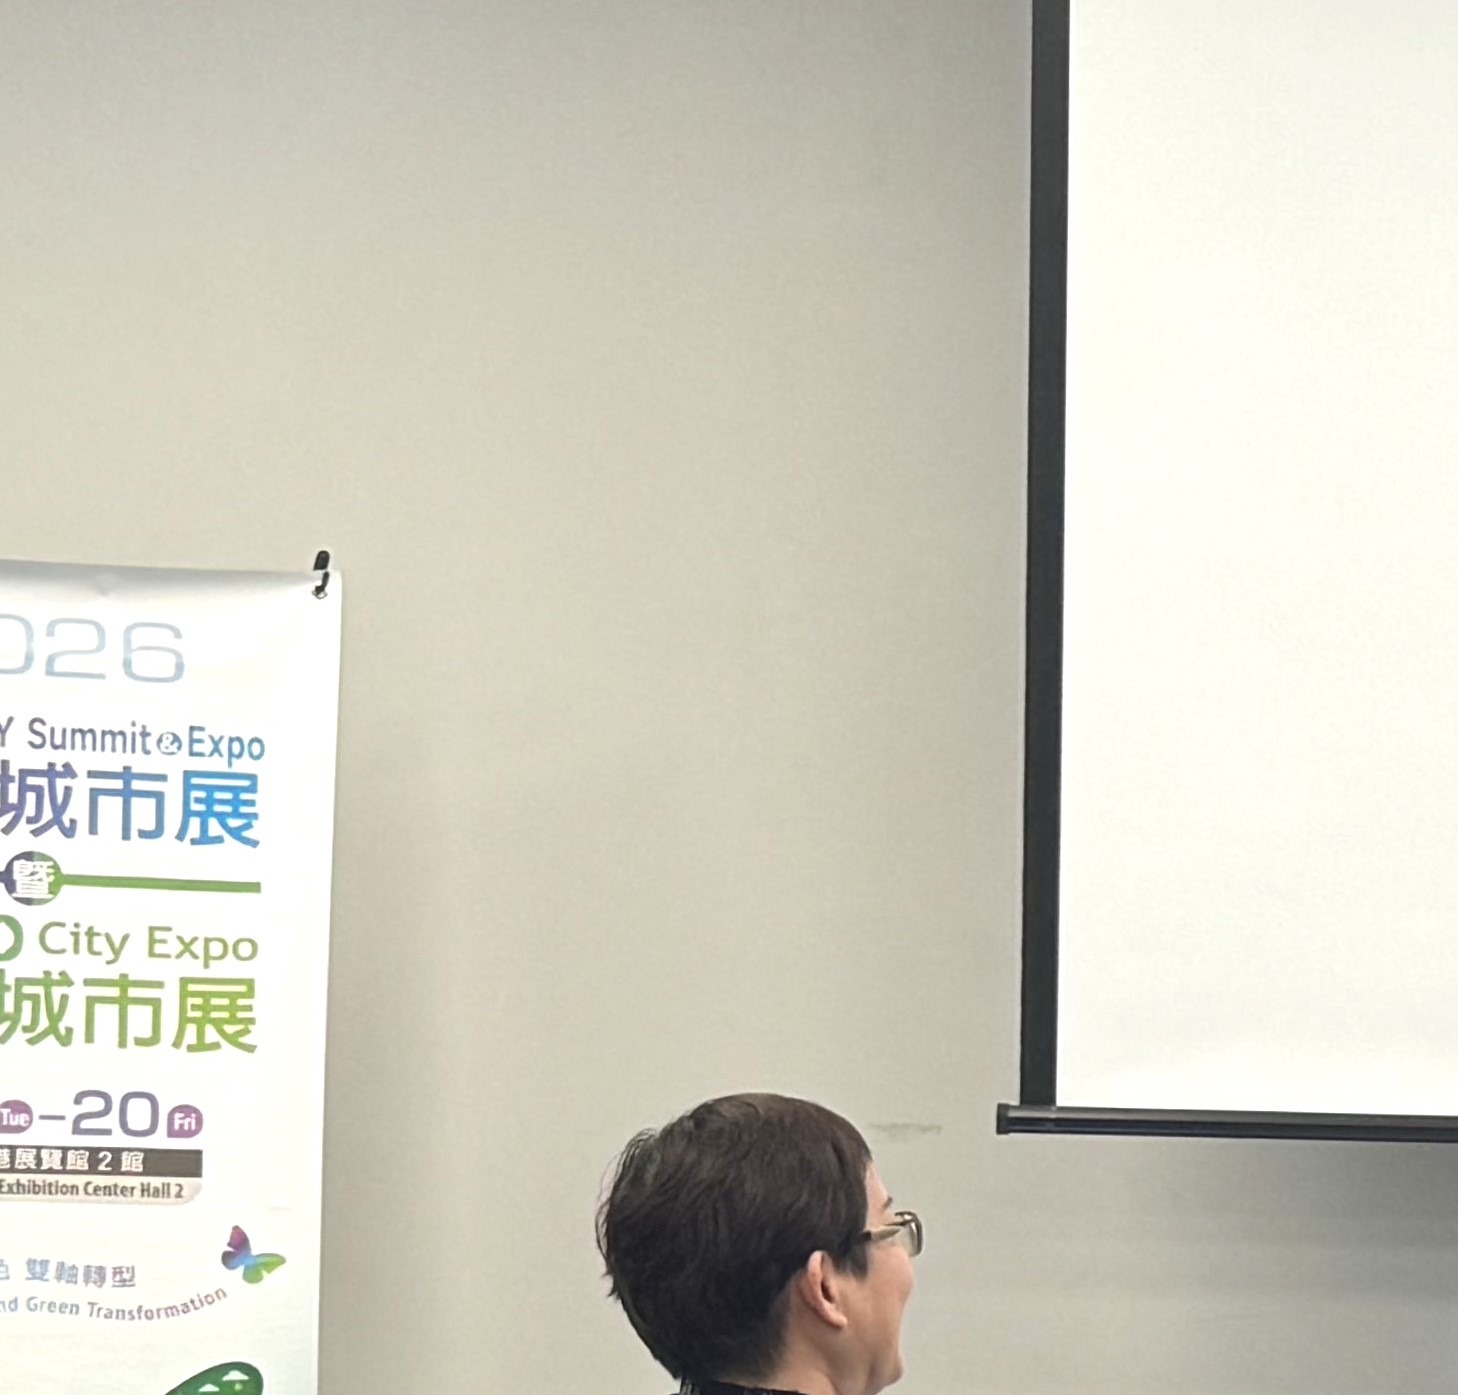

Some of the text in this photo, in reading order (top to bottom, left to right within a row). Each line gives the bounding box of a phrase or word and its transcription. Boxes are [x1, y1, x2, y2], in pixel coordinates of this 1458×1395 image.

[27, 717, 152, 756] Summit
[188, 725, 266, 769] Expo
[0, 759, 260, 849] 城市展
[38, 921, 130, 965] City
[147, 926, 259, 969] Expo
[0, 970, 258, 1054] 城市展
[173, 1112, 197, 1131] Fri
[97, 1150, 113, 1171] 2
[120, 1151, 144, 1172] 館
[0, 1179, 184, 1199] Exhibition Center Hall 2
[26, 1296, 80, 1316] Green
[87, 1287, 228, 1322] Transformation
